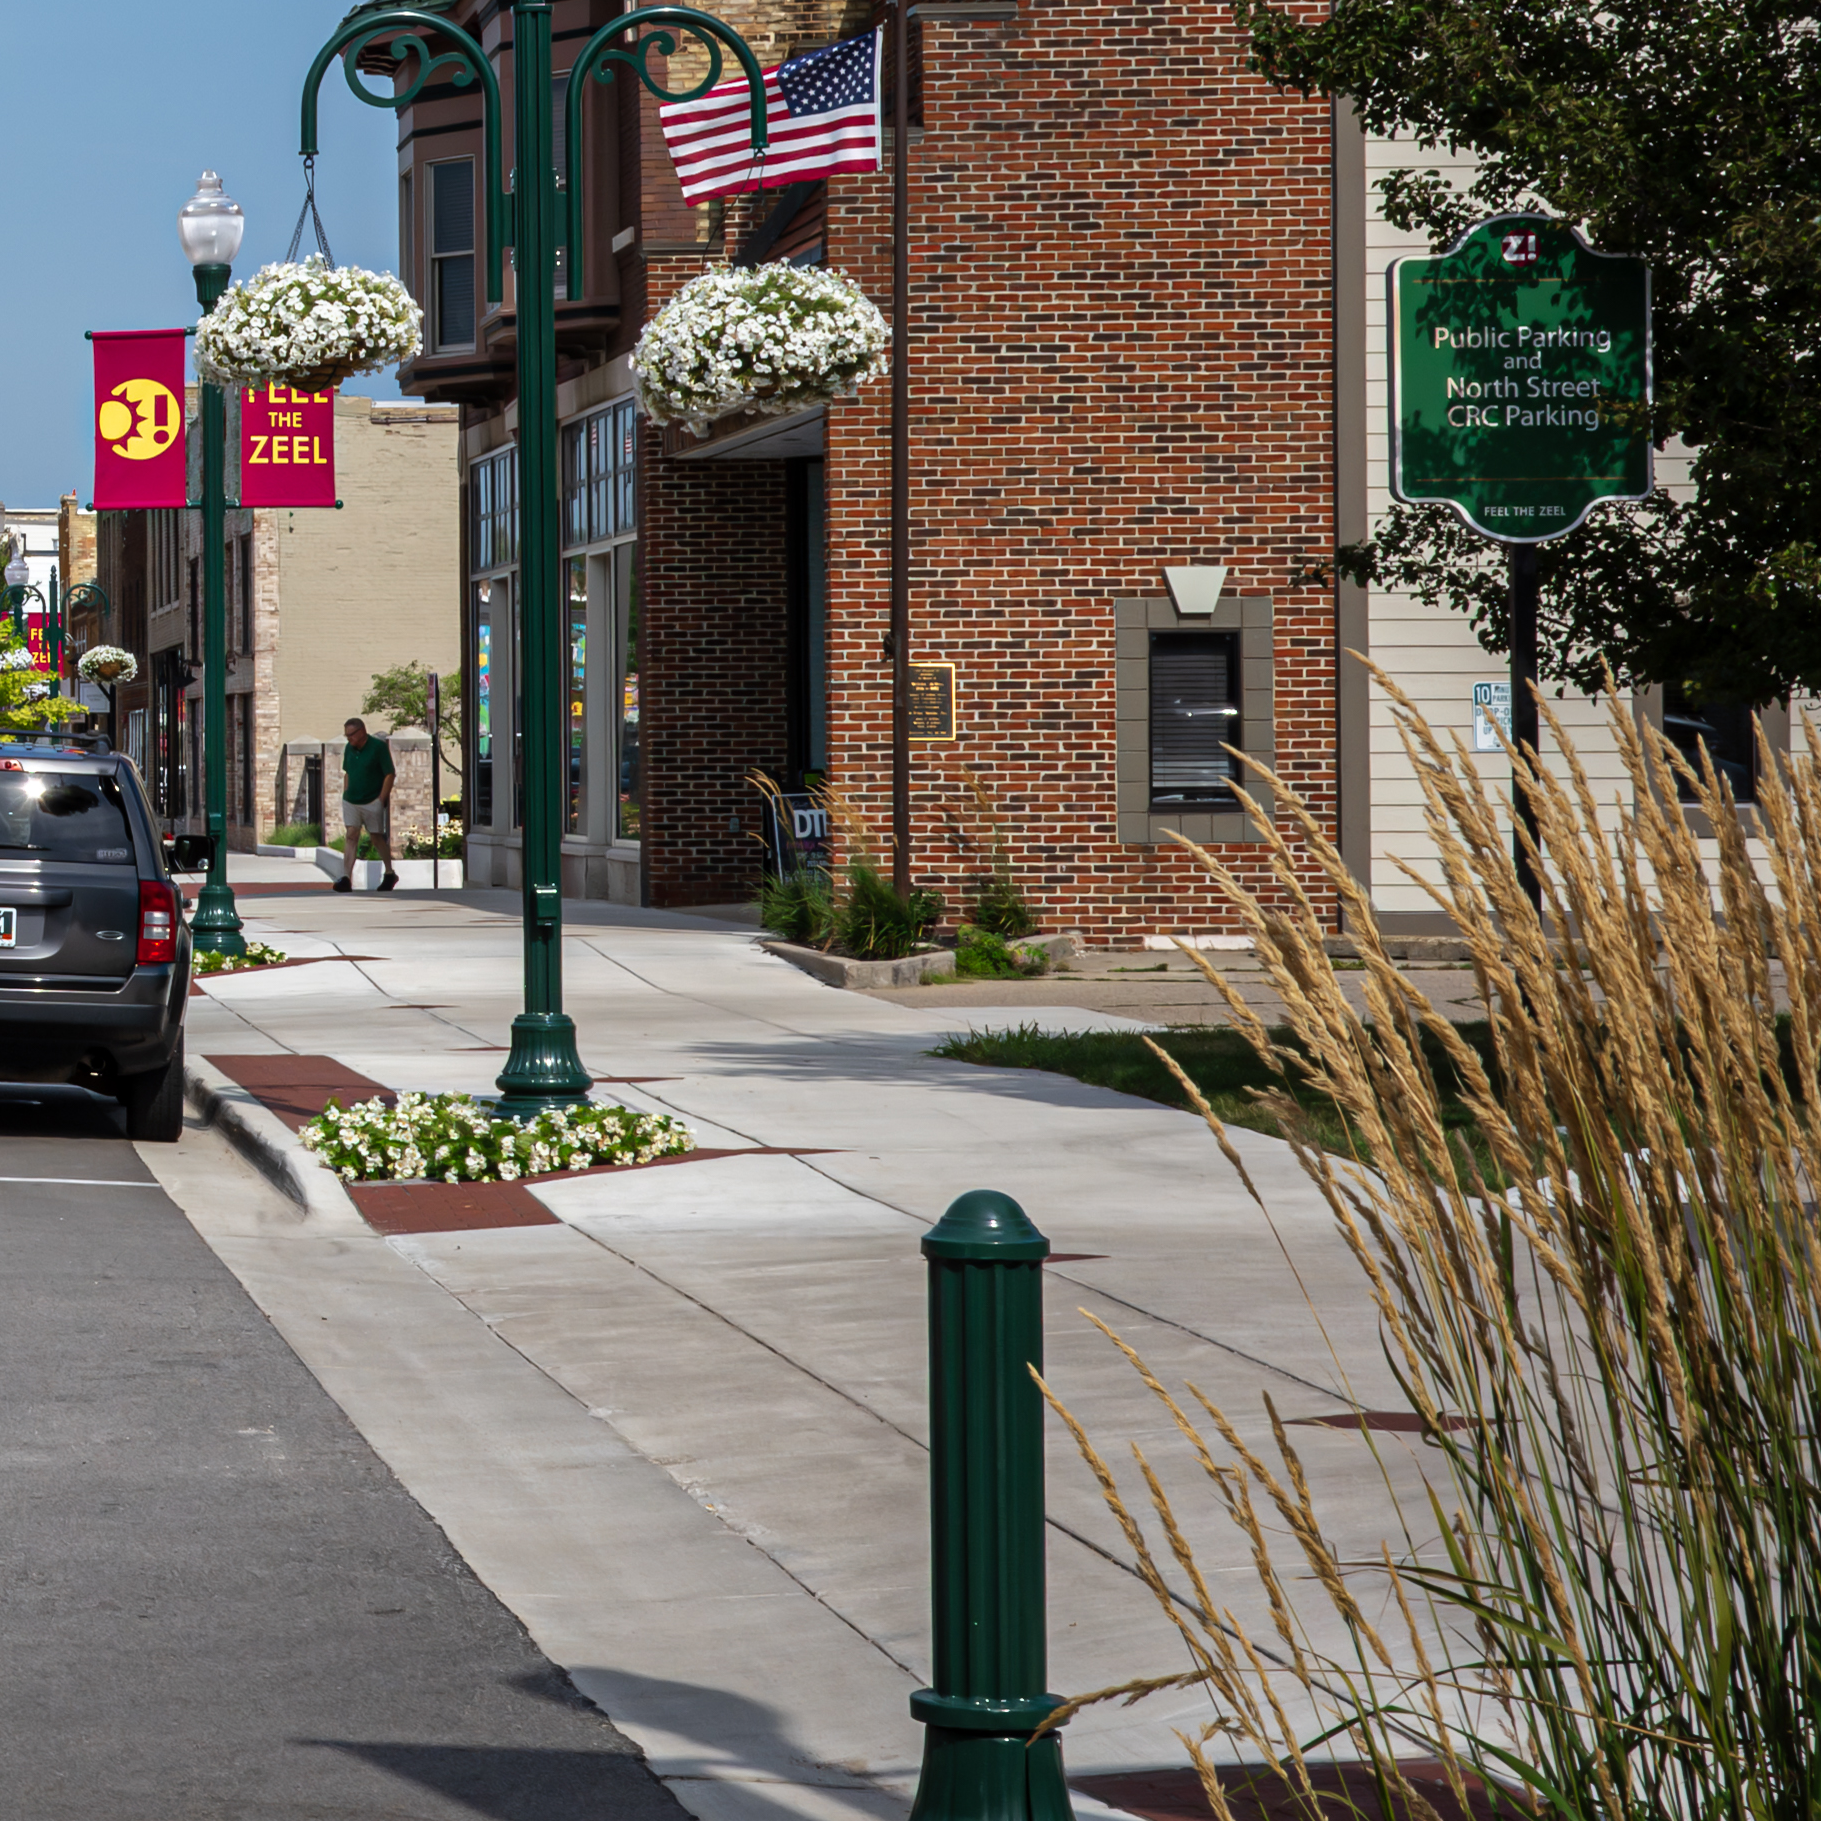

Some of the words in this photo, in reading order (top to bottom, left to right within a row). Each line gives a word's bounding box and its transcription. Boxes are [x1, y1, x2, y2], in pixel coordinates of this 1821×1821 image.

[1502, 235, 1537, 261] Z!
[1434, 326, 1511, 349] Public
[1517, 325, 1611, 353] Parking
[1503, 351, 1542, 370] and
[1446, 376, 1519, 399] North
[1527, 376, 1601, 398] Street
[268, 411, 303, 428] THE
[1447, 405, 1499, 427] CRC
[1506, 404, 1599, 431] Parking
[248, 435, 328, 464] ZEEL
[1484, 506, 1510, 517] FEEL
[1513, 506, 1535, 517] THE
[1539, 505, 1566, 516] ZEEL
[1475, 686, 1491, 703] 10
